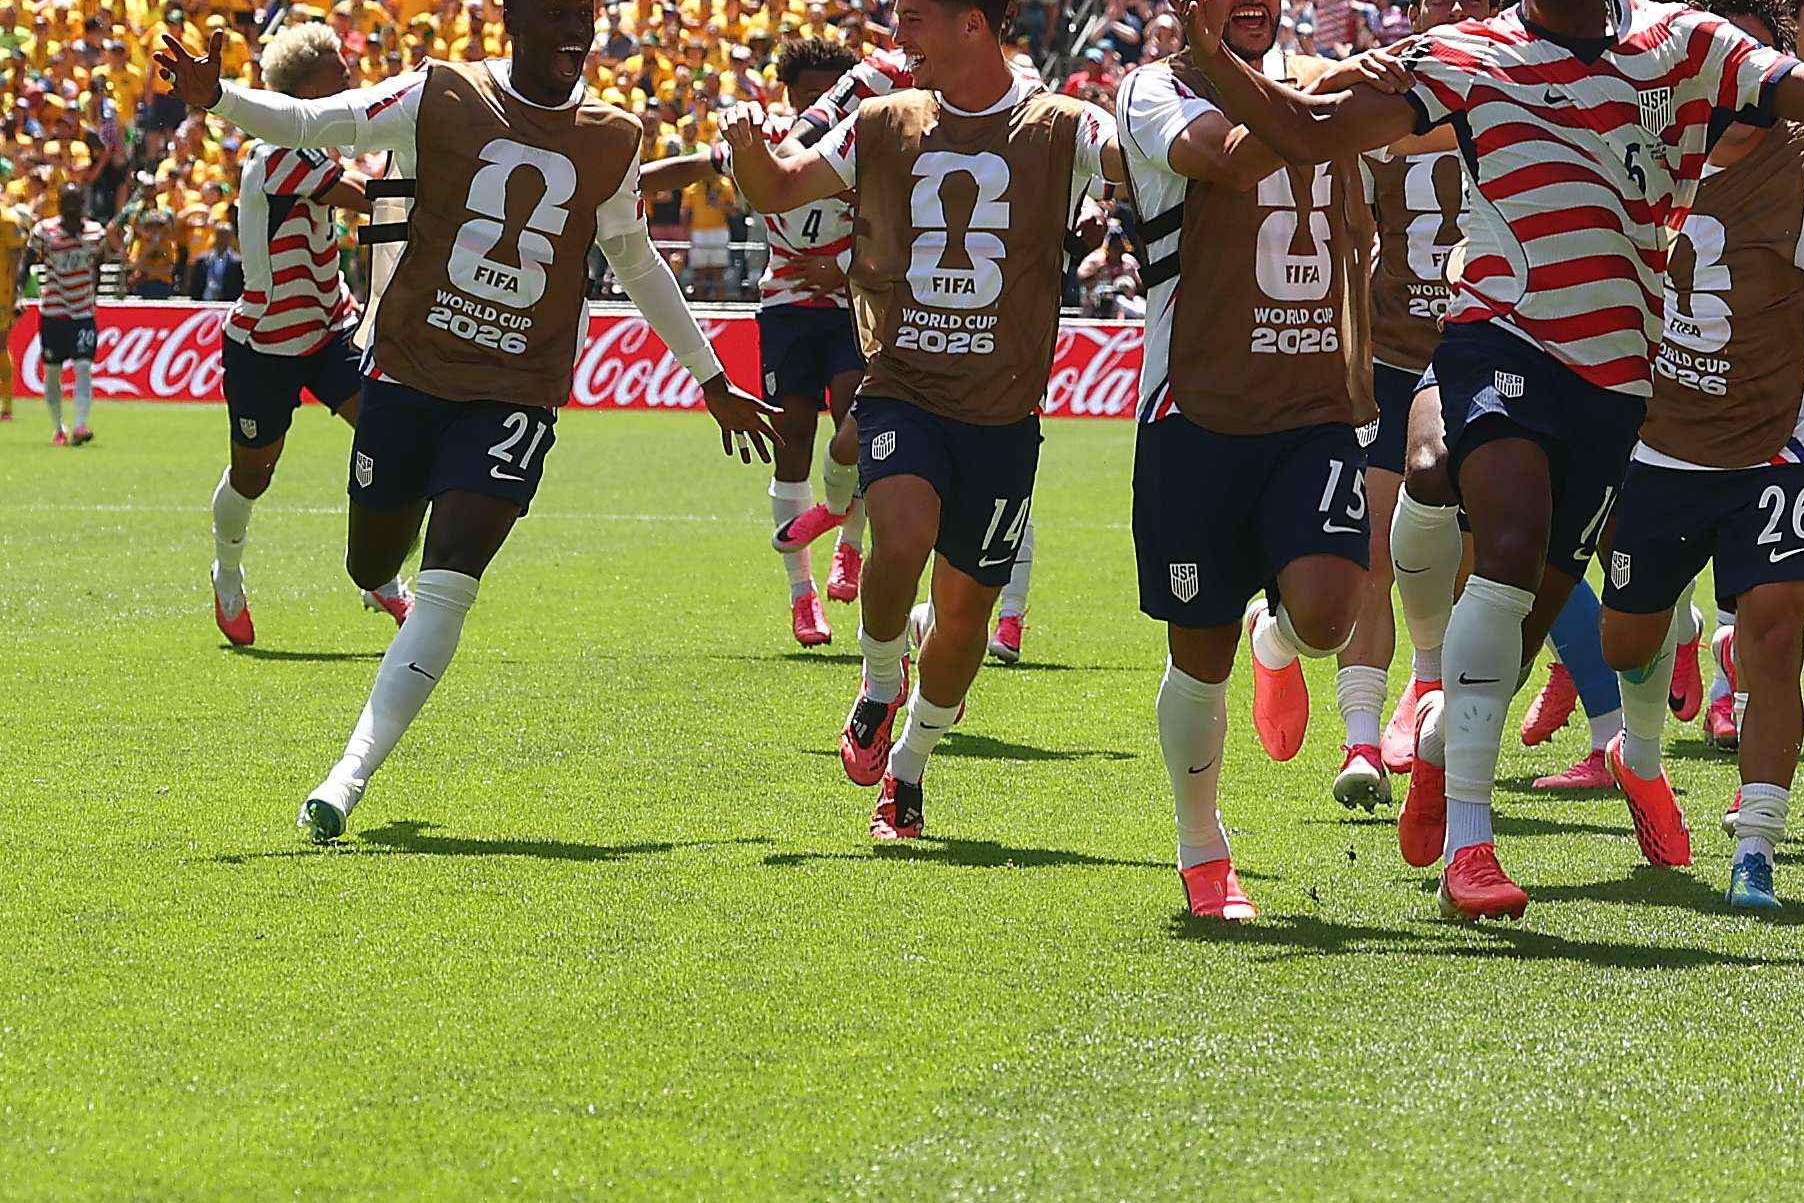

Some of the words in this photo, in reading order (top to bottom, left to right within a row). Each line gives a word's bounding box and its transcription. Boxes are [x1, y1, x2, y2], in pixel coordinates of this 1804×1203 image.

[1640, 88, 1669, 110] USA
[802, 209, 823, 244] 4
[473, 266, 519, 293] FIFA
[932, 276, 976, 294] FIFA
[1286, 265, 1320, 284] FIFA
[1407, 283, 1450, 297] WOR
[436, 289, 497, 321] WORLD
[499, 313, 533, 331] CUP
[902, 307, 962, 329] WORLD
[965, 315, 998, 330] CUP
[1254, 307, 1310, 324] WORLD
[1313, 307, 1333, 325] CUP
[1408, 298, 1452, 317] 20
[426, 305, 528, 355] 2026
[896, 326, 995, 353] 2026
[1251, 326, 1339, 355] 2026
[1658, 342, 1692, 367] ORLD
[1694, 357, 1731, 374] CUP
[1655, 356, 1727, 396] 026
[487, 411, 547, 470] 21
[1318, 459, 1366, 521] 15
[981, 497, 1029, 551] 14
[1172, 565, 1196, 580] USA
